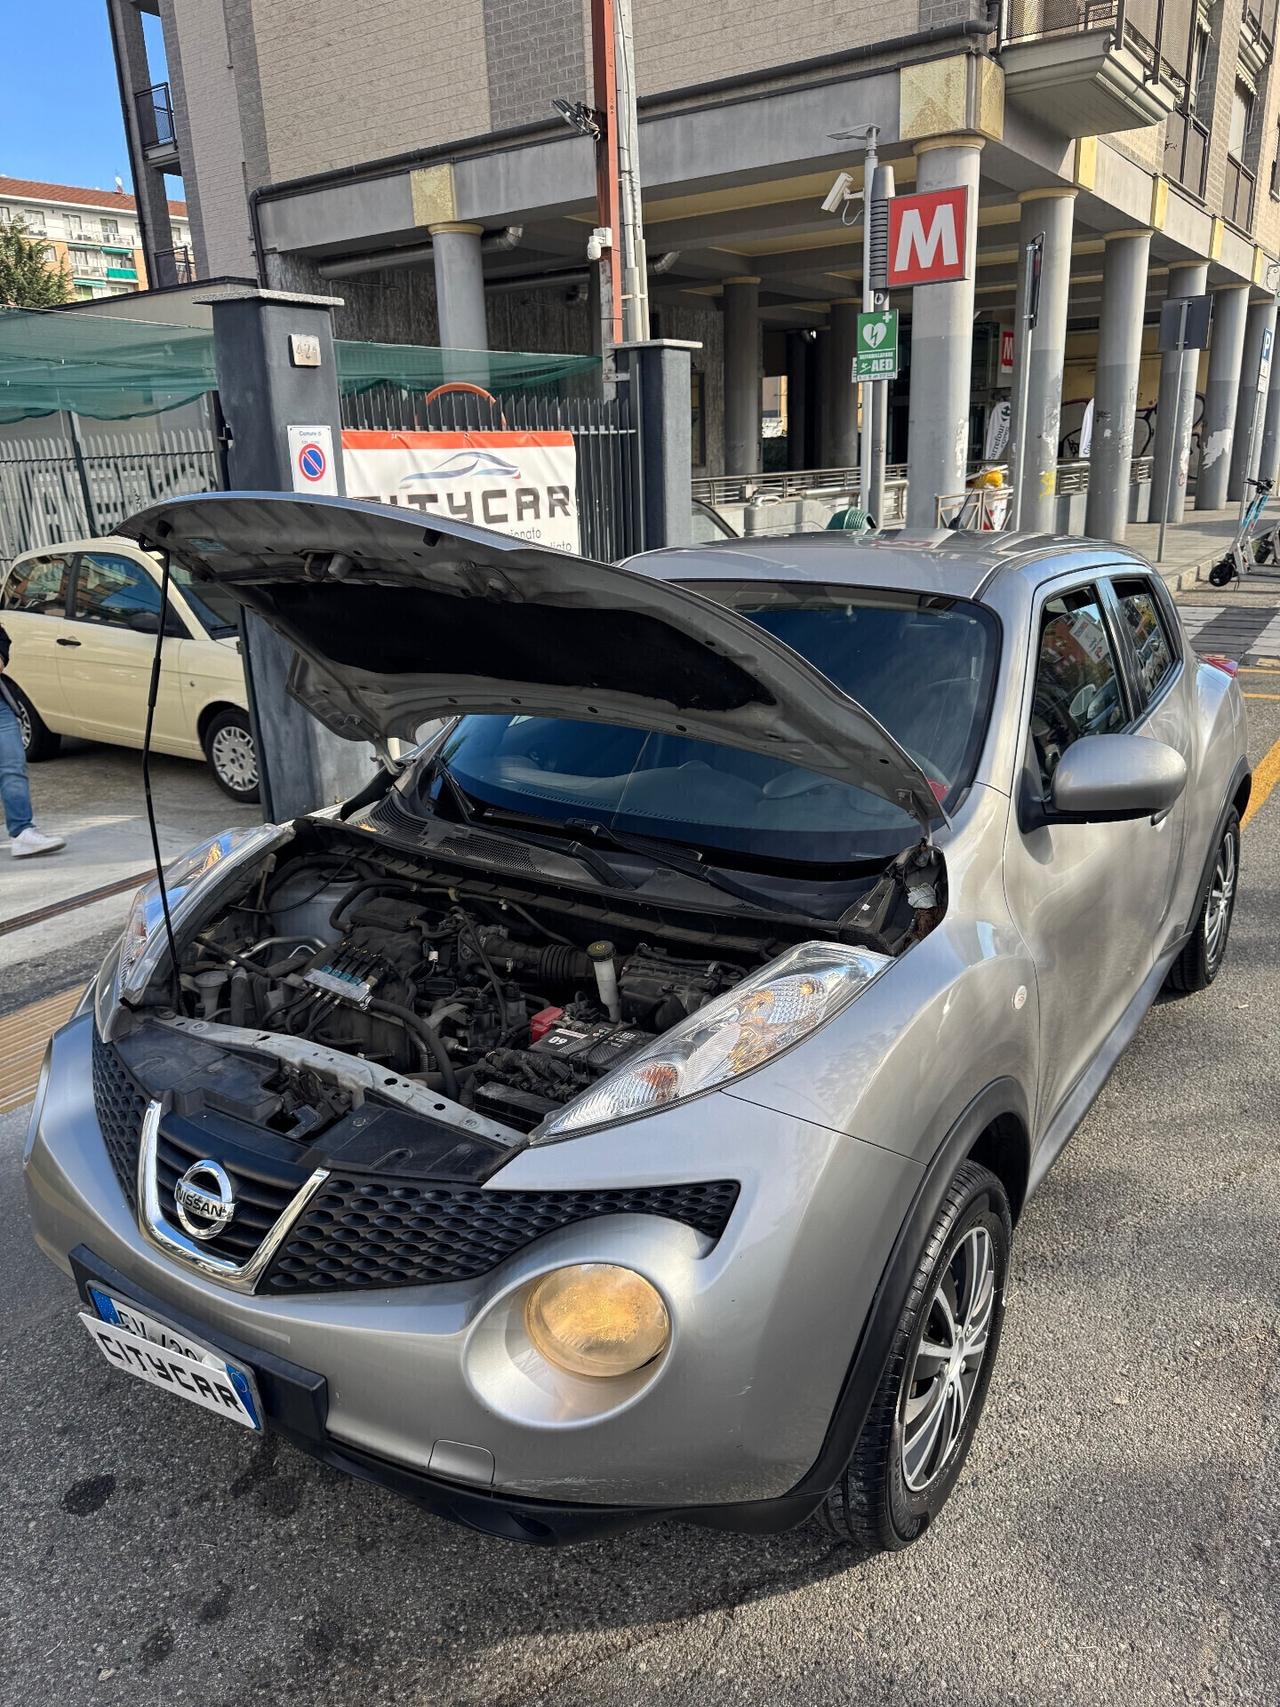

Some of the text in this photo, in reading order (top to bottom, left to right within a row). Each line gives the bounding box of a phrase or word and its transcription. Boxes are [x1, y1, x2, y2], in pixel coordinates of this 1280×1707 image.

[894, 203, 959, 272] M
[871, 358, 894, 371] AED
[352, 485, 571, 525] TYCAR
[176, 1182, 224, 1218] NISSAN
[97, 1331, 244, 1414] CITYCAR
